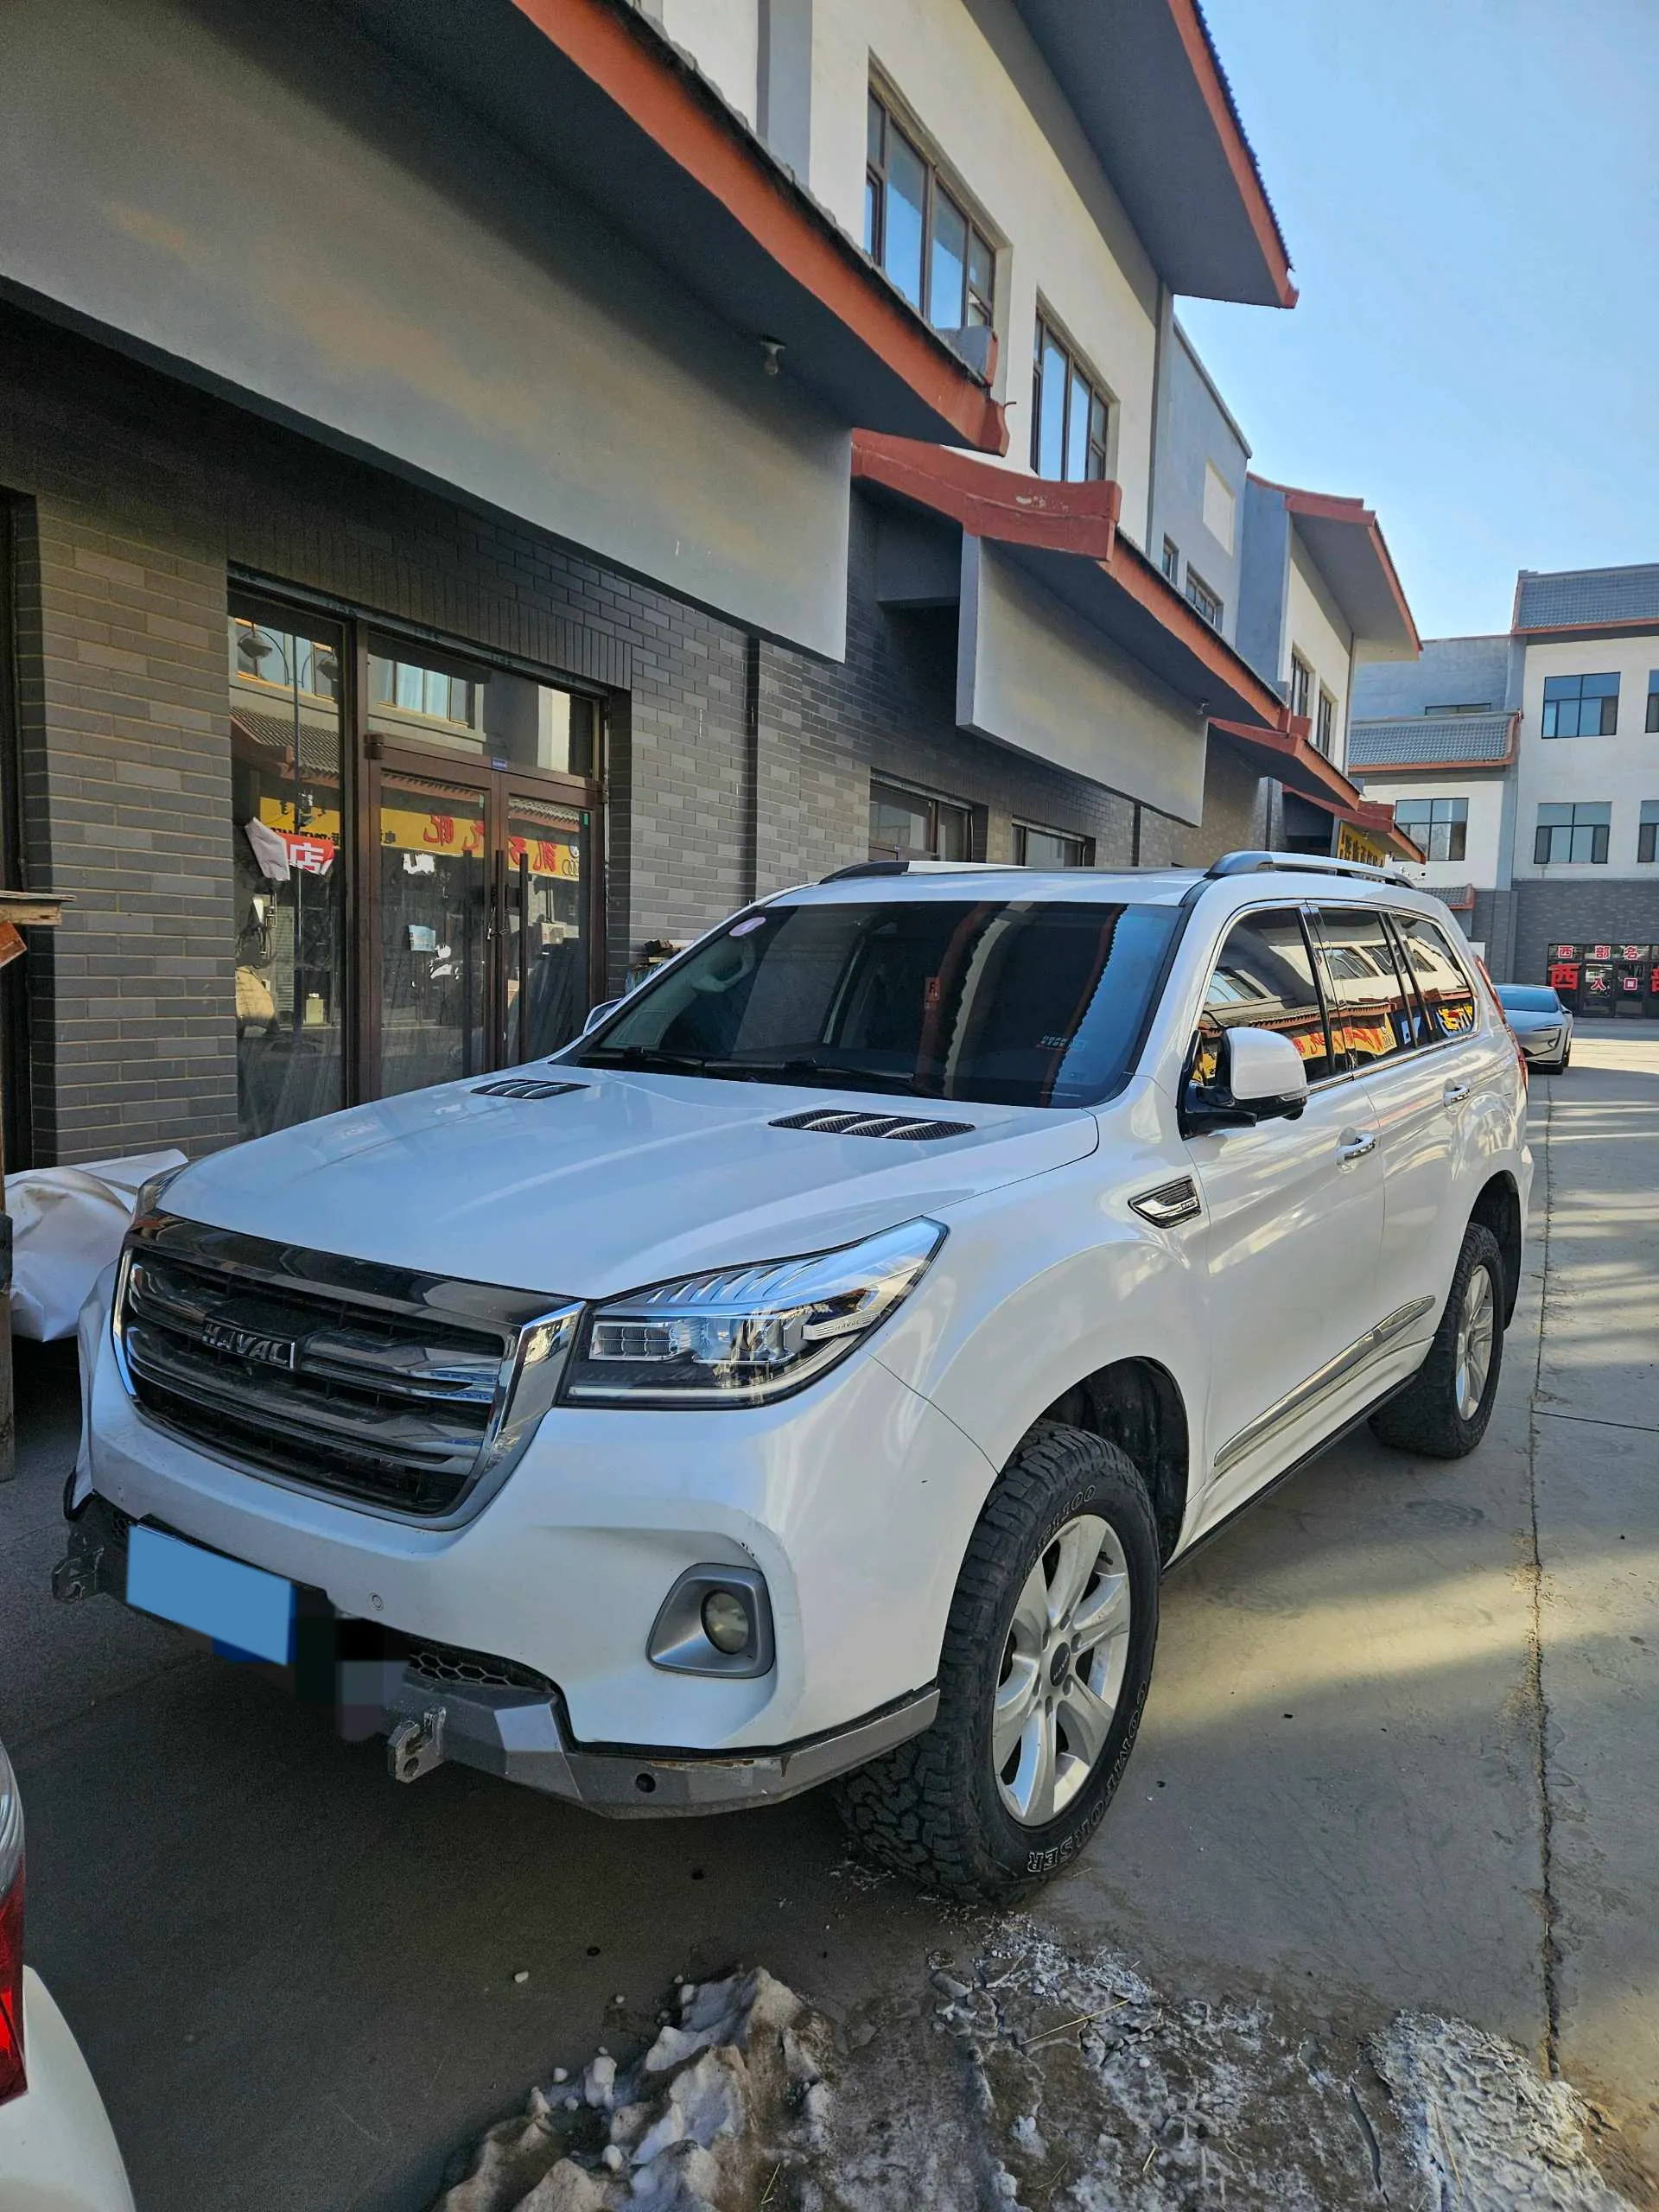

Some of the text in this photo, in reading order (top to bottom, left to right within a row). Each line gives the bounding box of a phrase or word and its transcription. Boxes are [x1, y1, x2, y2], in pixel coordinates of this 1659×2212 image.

[289, 842, 325, 872] 店
[1558, 945, 1638, 960] 西部名
[1591, 977, 1637, 991] 入口
[200, 1324, 288, 1364] HAVAL
